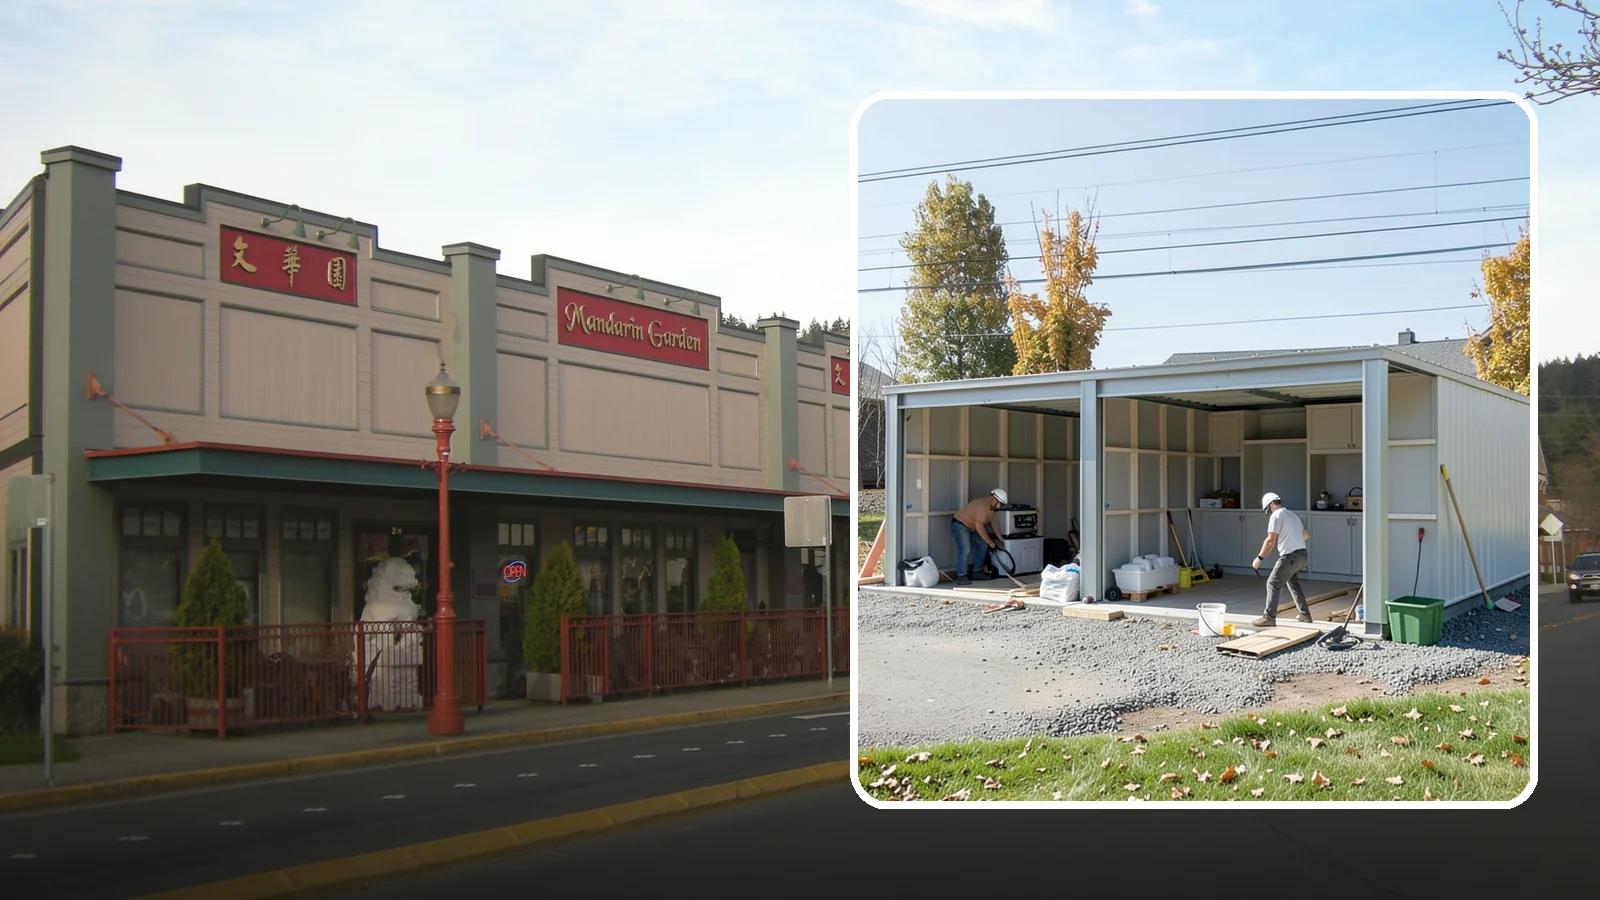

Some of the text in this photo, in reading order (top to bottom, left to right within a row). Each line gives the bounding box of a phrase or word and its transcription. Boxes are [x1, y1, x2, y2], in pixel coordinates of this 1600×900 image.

[230, 235, 346, 290] 文華園
[564, 302, 701, 352] Mandarin Garden
[503, 566, 527, 578] OPEN
